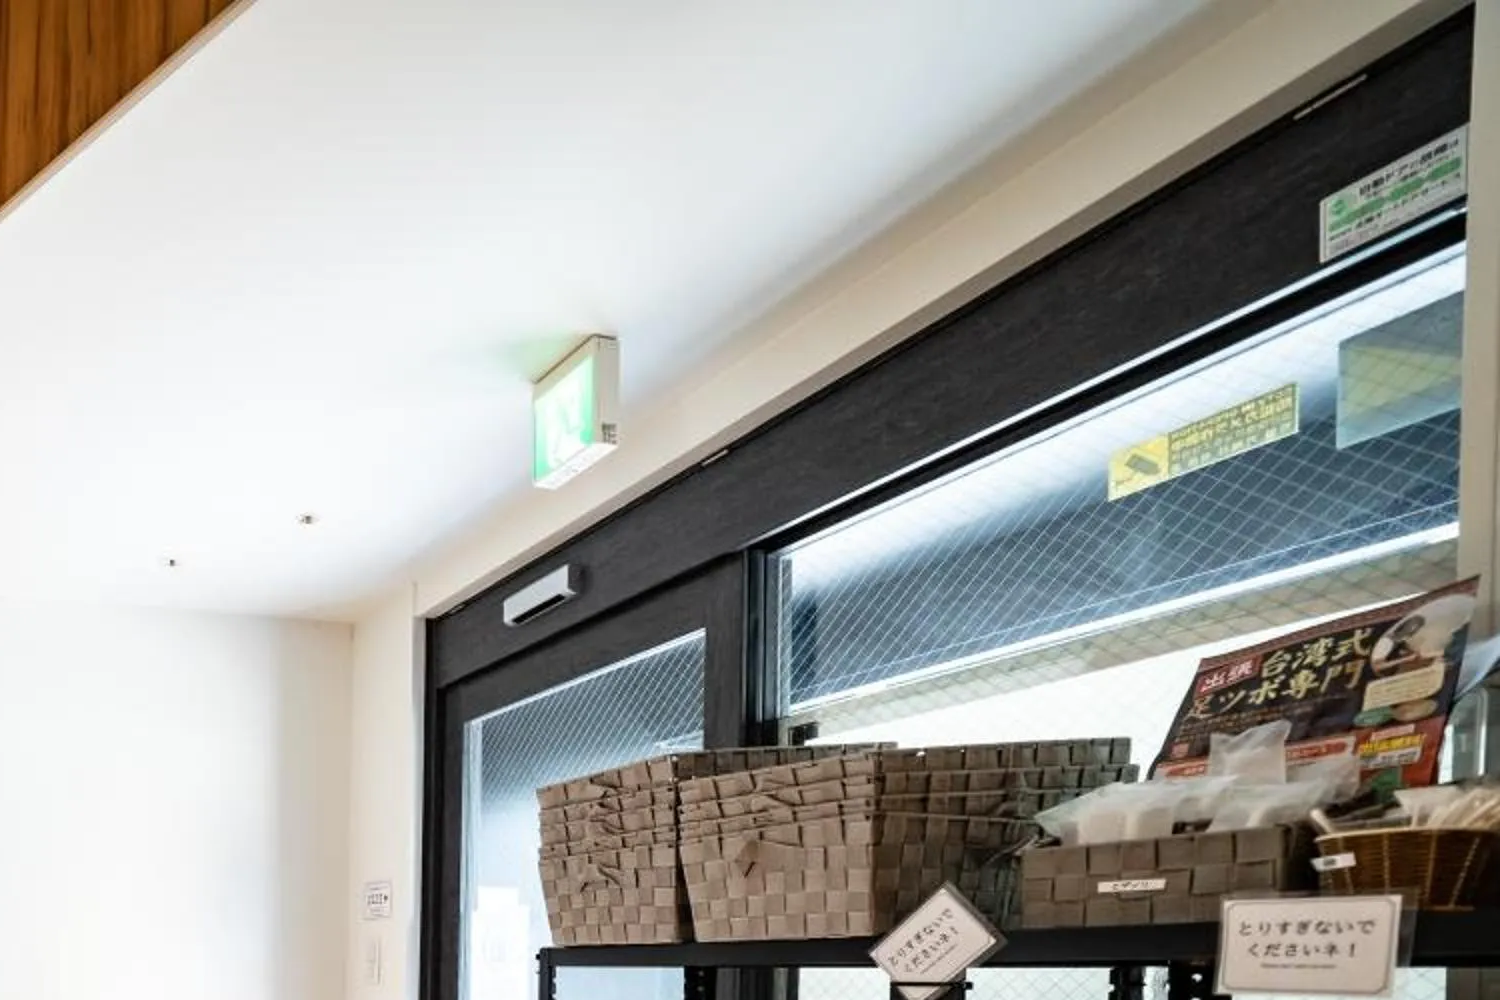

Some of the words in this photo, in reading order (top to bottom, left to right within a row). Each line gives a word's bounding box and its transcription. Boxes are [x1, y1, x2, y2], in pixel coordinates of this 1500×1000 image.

[1261, 627, 1373, 678] 台湾式
[1238, 919, 1376, 936] とりすぎないで
